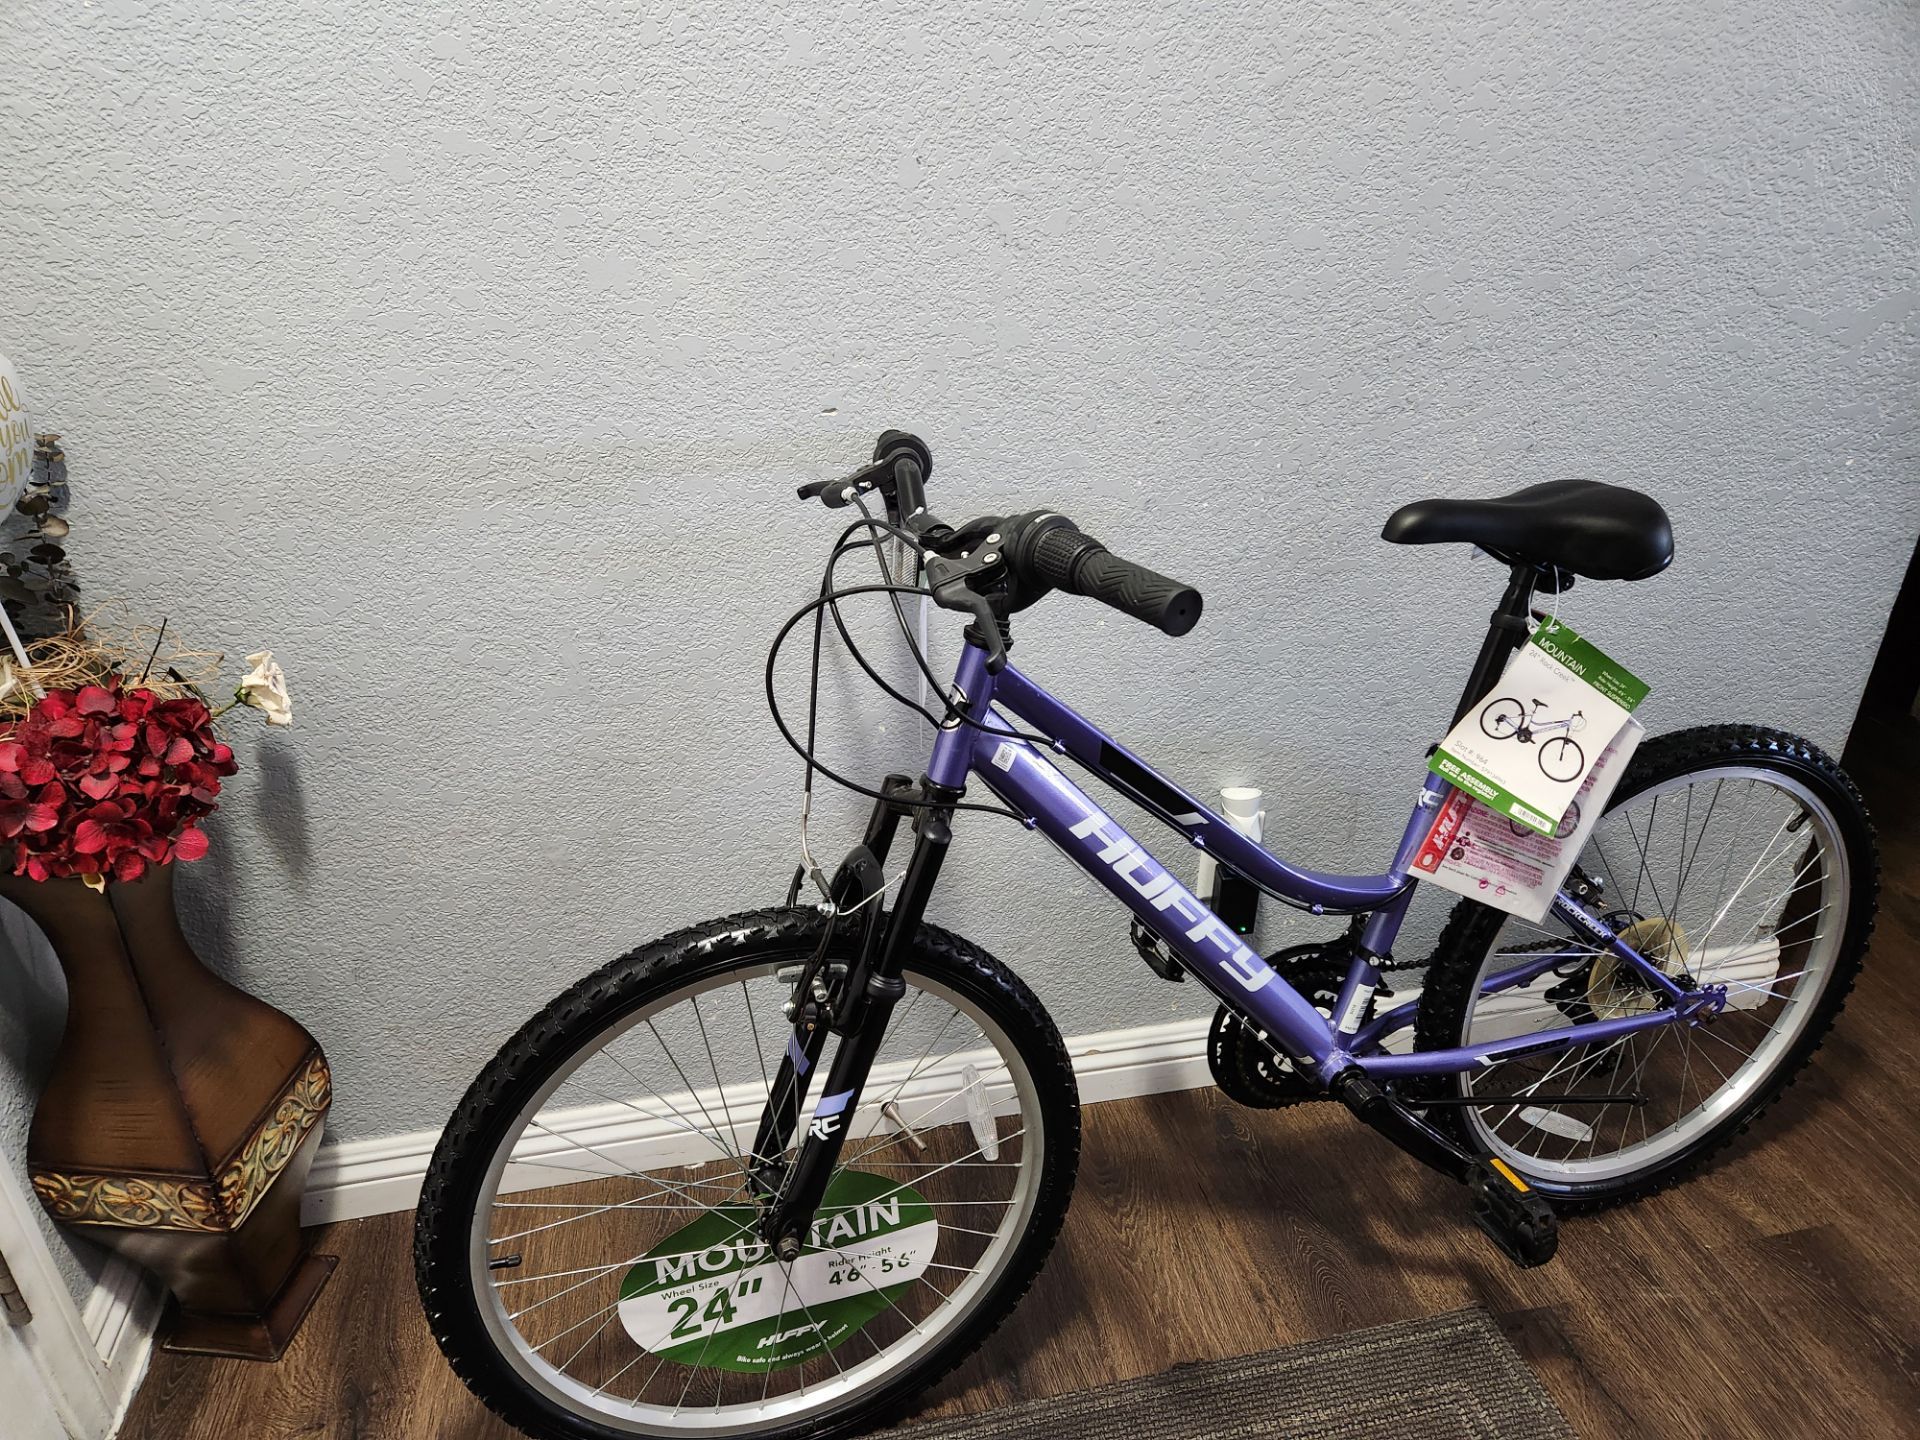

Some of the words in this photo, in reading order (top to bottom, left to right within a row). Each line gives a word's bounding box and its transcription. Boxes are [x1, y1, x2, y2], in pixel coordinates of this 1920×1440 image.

[1538, 637, 1587, 676] MOUNTAIN
[1441, 759, 1461, 773] FREE
[1462, 772, 1499, 796] ASSEMBLY
[1069, 810, 1277, 992] HUFFY
[808, 1115, 841, 1141] RC
[655, 1196, 900, 1285] MOUTAIN
[828, 1257, 855, 1269] Rider
[660, 1284, 696, 1301] Wheel
[698, 1279, 720, 1291] Size
[667, 1277, 763, 1339] 24"
[756, 1319, 828, 1350] HUFFY
[736, 1355, 751, 1363] Bike
[781, 1350, 804, 1361] always
[805, 1341, 822, 1352] wear
